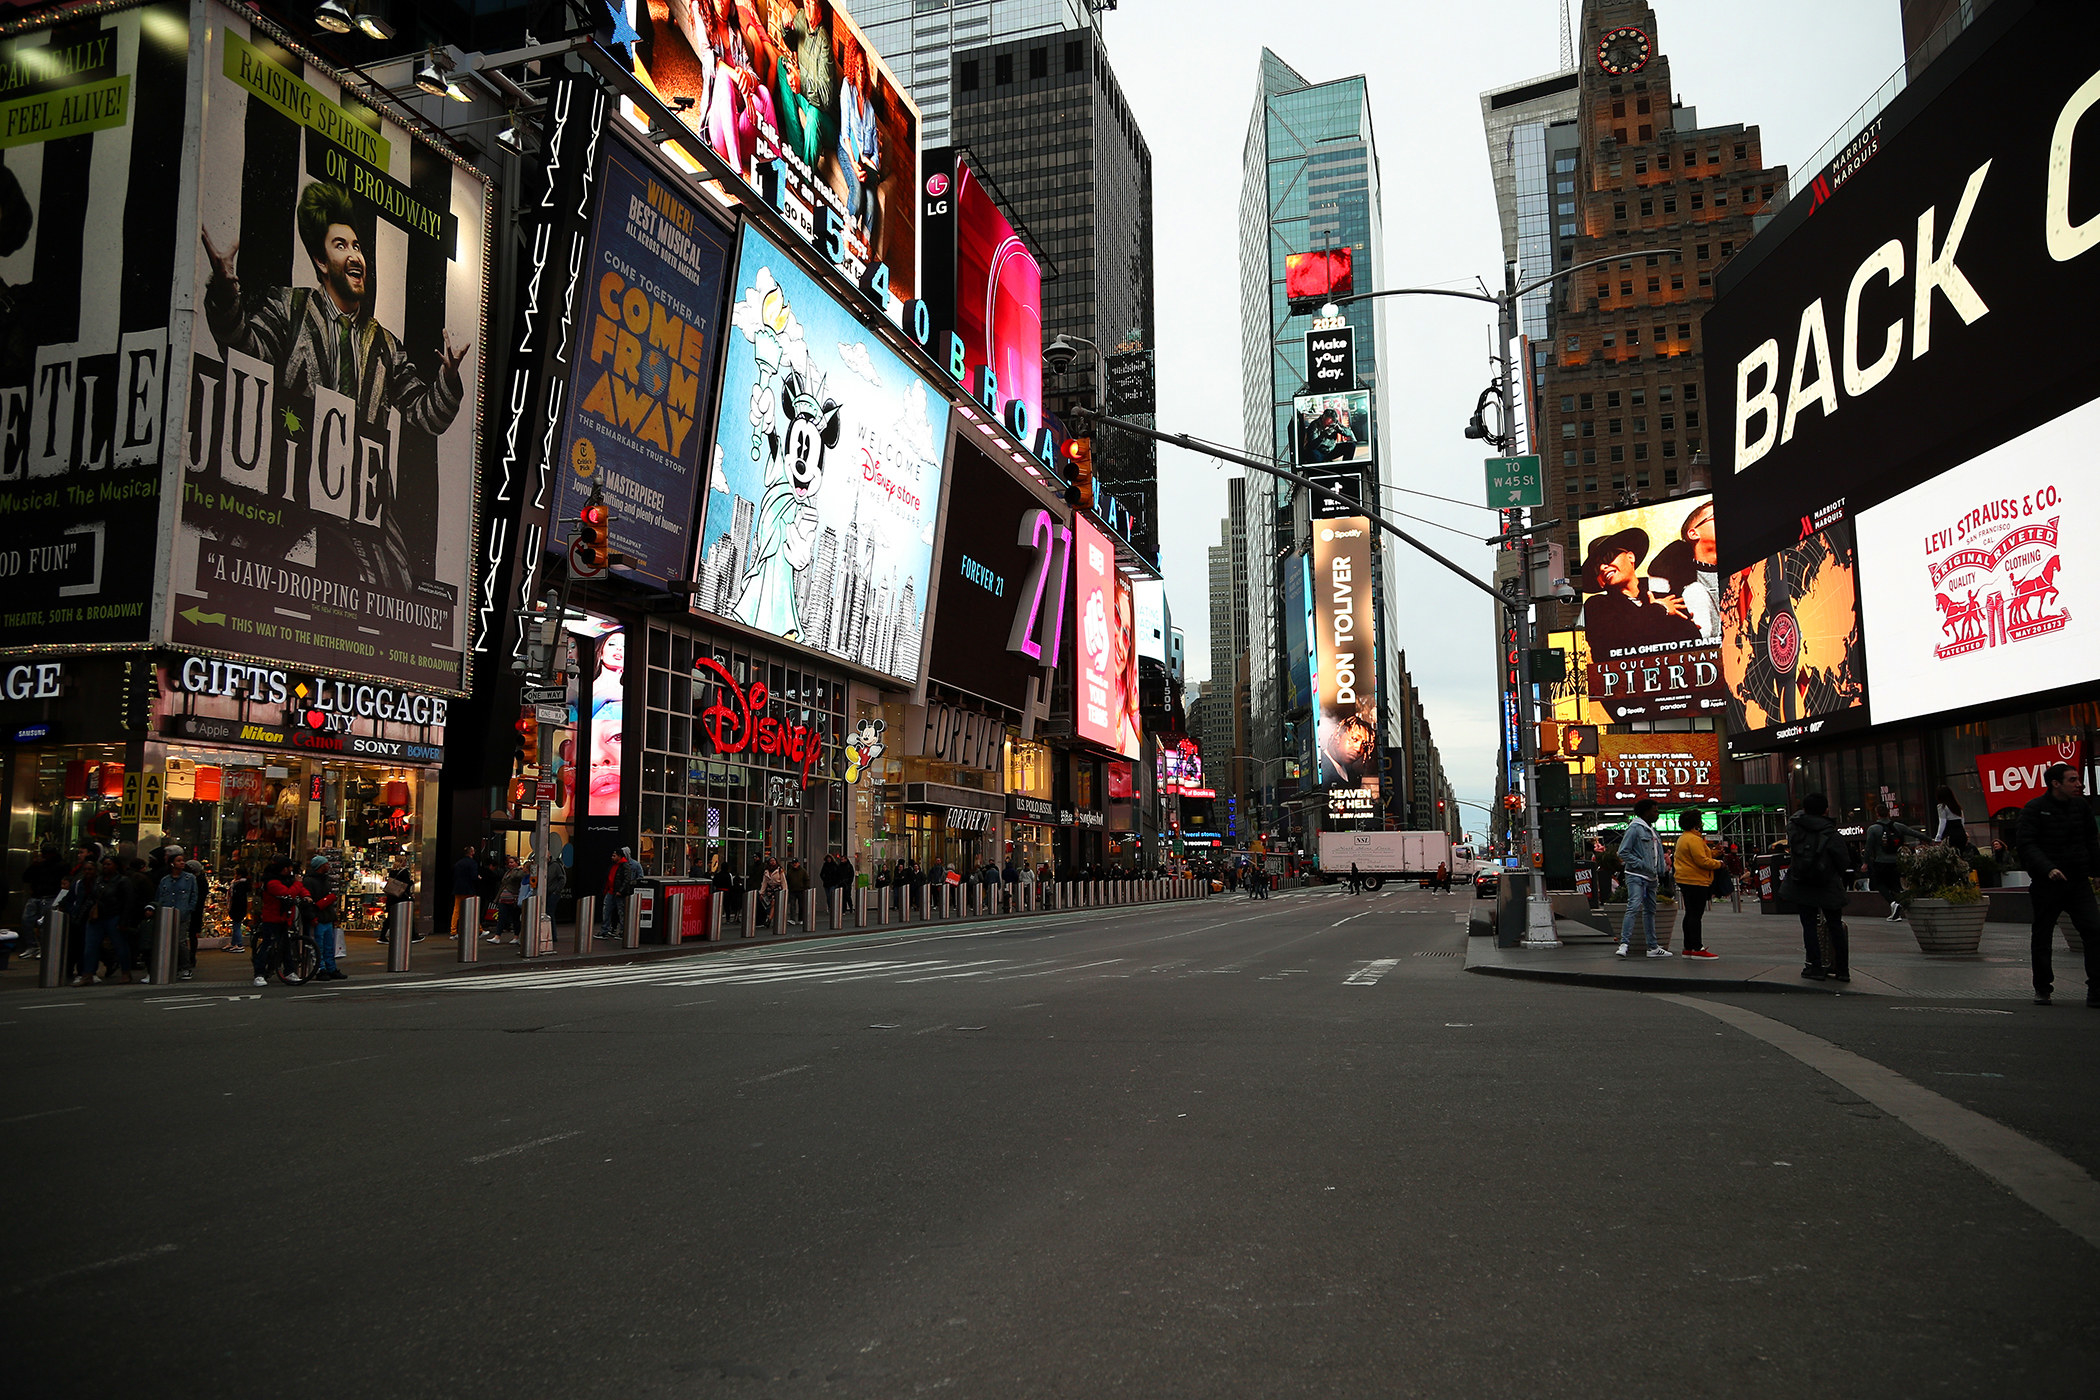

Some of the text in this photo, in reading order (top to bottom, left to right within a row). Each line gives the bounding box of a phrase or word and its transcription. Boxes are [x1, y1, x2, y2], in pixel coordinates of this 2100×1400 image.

[6, 86, 122, 137] FEEL ALIVE!
[239, 49, 378, 165] RAISING SPIRITS
[756, 110, 779, 150] Talk
[782, 142, 812, 184] about
[1832, 117, 1883, 174] MARRIOTT
[1833, 140, 1879, 190] MARQUIS
[326, 149, 442, 241] ON BROADWAY!
[801, 184, 814, 206] an
[648, 178, 695, 236] WINNER!
[784, 200, 798, 220] go
[927, 201, 948, 216] LG
[628, 194, 701, 270] BEST MUSICAL
[626, 222, 700, 286] ALL ACROSS NORTH AMERICA
[603, 250, 706, 330] COME TOGETHER AT
[599, 271, 704, 372] COME
[1313, 317, 1345, 330] 2020
[1734, 157, 1992, 475] BACK
[1312, 338, 1347, 351] Make
[1315, 353, 1345, 367] your
[1317, 366, 1344, 380] day.
[581, 370, 693, 459] AWAY
[578, 414, 687, 475] THE REMARKABLE TRUE STORY
[858, 424, 920, 481] WELCOME
[579, 464, 590, 472] Pick
[1506, 462, 1520, 473] TO
[605, 469, 665, 513] MASTERPIECE!
[1494, 475, 1534, 487] W 45 St
[0, 478, 161, 514] Musical. The Musical.
[183, 482, 285, 528] The Musical.
[896, 486, 920, 511] store
[624, 502, 636, 516] and
[636, 507, 655, 525] plenty
[1814, 497, 1846, 519] MARRIOTT
[1814, 510, 1844, 531] MARQUIS
[1925, 485, 2062, 555] LEVI STRAUSS & CO.
[616, 534, 642, 549] BROADWAY
[1334, 529, 1362, 539] Spotify
[1966, 523, 2011, 545] SAN FRANCISCO
[1934, 528, 2055, 584] ORIGINAL RIVETED
[2004, 549, 2041, 572] CLOTHING
[231, 556, 360, 611] JAW-DROPPING
[961, 554, 1004, 598] FOREVER 21
[1948, 572, 1976, 592] QUALITY
[4, 602, 144, 628] THEATRE, 50TH & BROADWAY
[321, 605, 331, 613] NEW
[332, 608, 343, 616] YORK
[343, 610, 357, 619] TIMES
[1332, 556, 1356, 705] DON TOLIVER
[2014, 620, 2063, 640] MAY 20 1873
[232, 617, 459, 673] THIS WAY TO THE NETHERWORLD 50TH & BROADWAY
[1610, 640, 1693, 657] DE LA GHETTO FT.
[1941, 641, 1981, 658] PATENTED
[1603, 662, 1718, 697] PIERD
[182, 657, 448, 728] GIFTS LUGGAGE
[528, 690, 561, 700] ONE WAY
[325, 714, 357, 735] NY
[541, 710, 550, 718] ONE
[696, 657, 823, 791] Disney
[18, 729, 46, 737] SAMSUNG
[922, 697, 1007, 773] FOREVER
[1809, 720, 1824, 732] 007
[199, 721, 441, 760] Apple Nikon Canon SONY BOWER
[311, 776, 320, 799] ATM
[1606, 768, 1709, 785] PIERDE
[124, 775, 138, 816] ATM
[145, 775, 160, 816] ATM
[1329, 789, 1371, 799] HEAVEN
[1881, 786, 1889, 794] NO
[1881, 793, 1896, 801] TIME
[1016, 798, 1039, 813] U.S. POLO
[1346, 799, 1374, 809] HELL
[1889, 809, 1900, 817] DIE
[946, 807, 991, 832] FOREVER 21
[1759, 866, 1772, 881] JERSEY
[1761, 882, 1772, 894] BOYS
